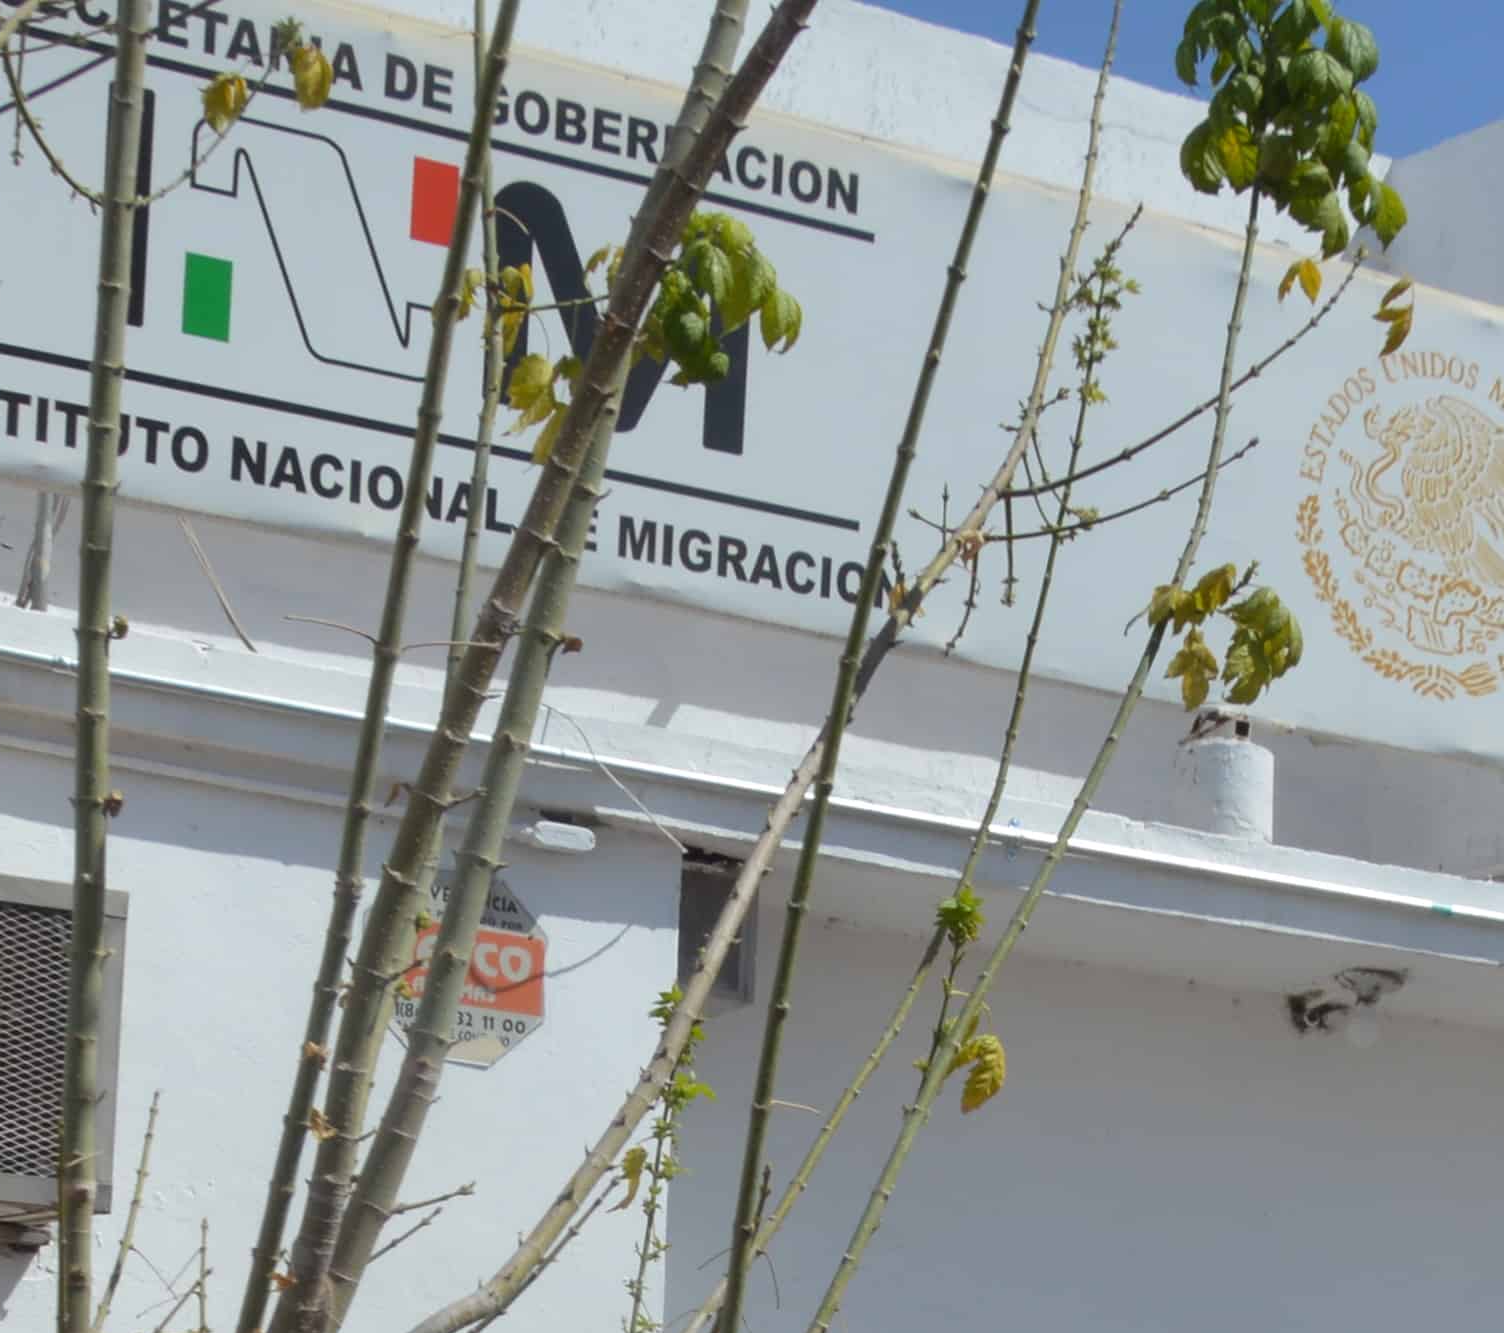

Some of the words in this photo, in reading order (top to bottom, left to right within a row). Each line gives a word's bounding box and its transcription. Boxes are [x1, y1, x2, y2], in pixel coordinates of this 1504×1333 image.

[384, 53, 453, 114] DE
[492, 84, 860, 214] OBERACION
[1299, 367, 1376, 482] ESTADOS
[1380, 351, 1479, 389] UNIDOS
[502, 1019, 526, 1034] 00
